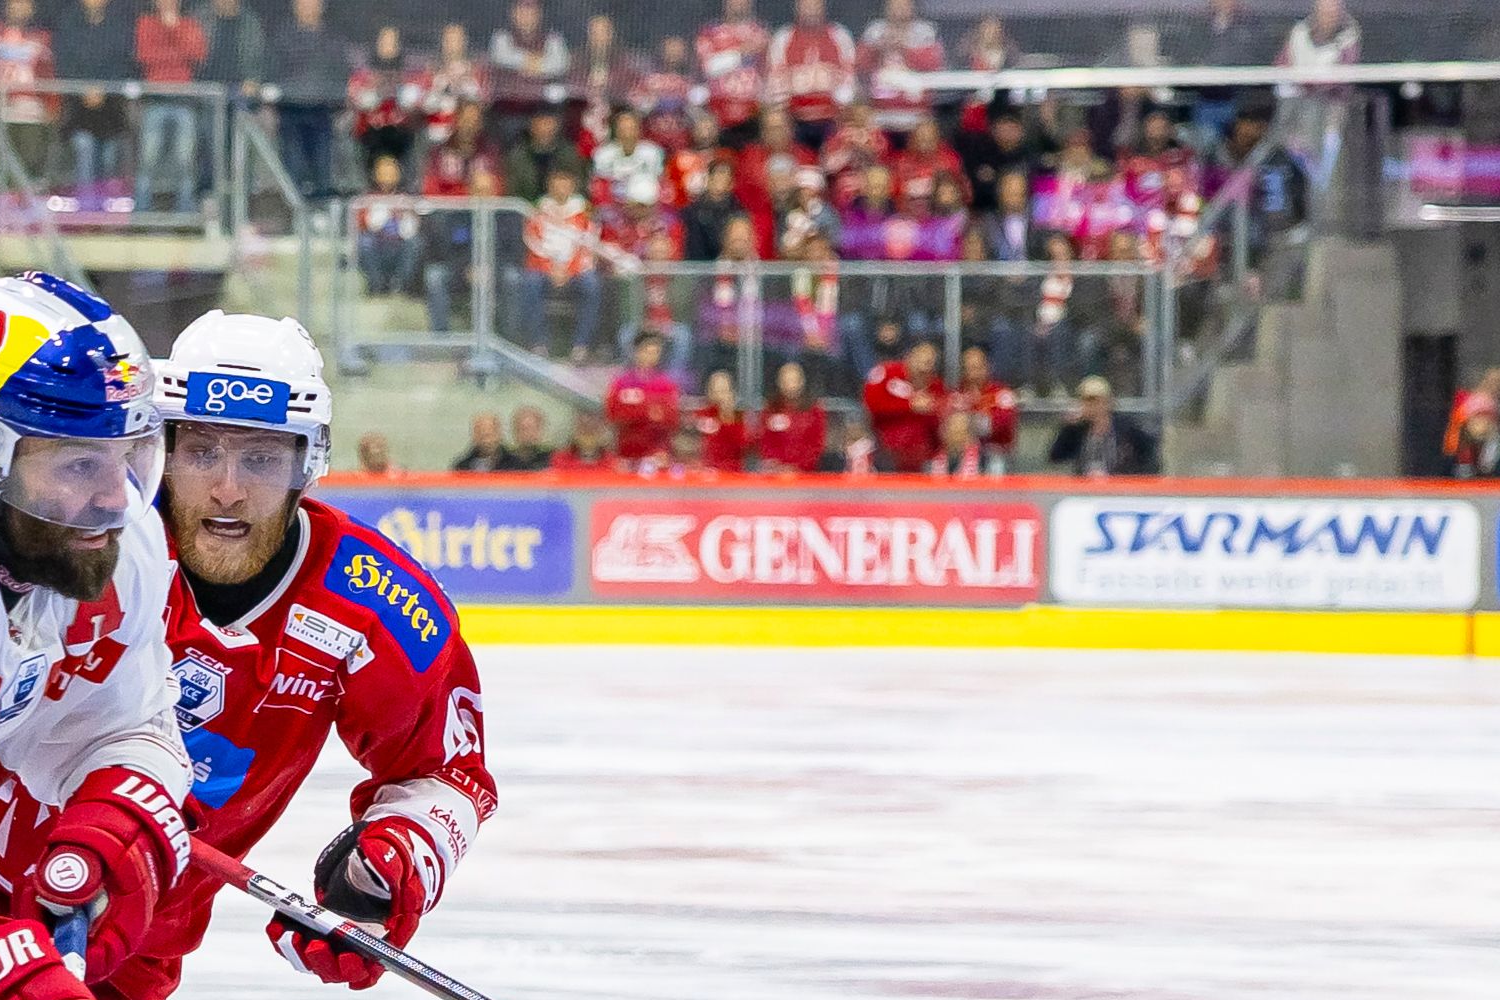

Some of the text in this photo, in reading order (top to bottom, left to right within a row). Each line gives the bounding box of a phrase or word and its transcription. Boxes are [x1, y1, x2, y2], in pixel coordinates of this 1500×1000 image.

[700, 513, 1038, 588] GENERALI
[1084, 511, 1451, 556] STARMANN
[343, 553, 440, 643] Hirter
[184, 646, 234, 676] CCM
[190, 669, 212, 688] 2024
